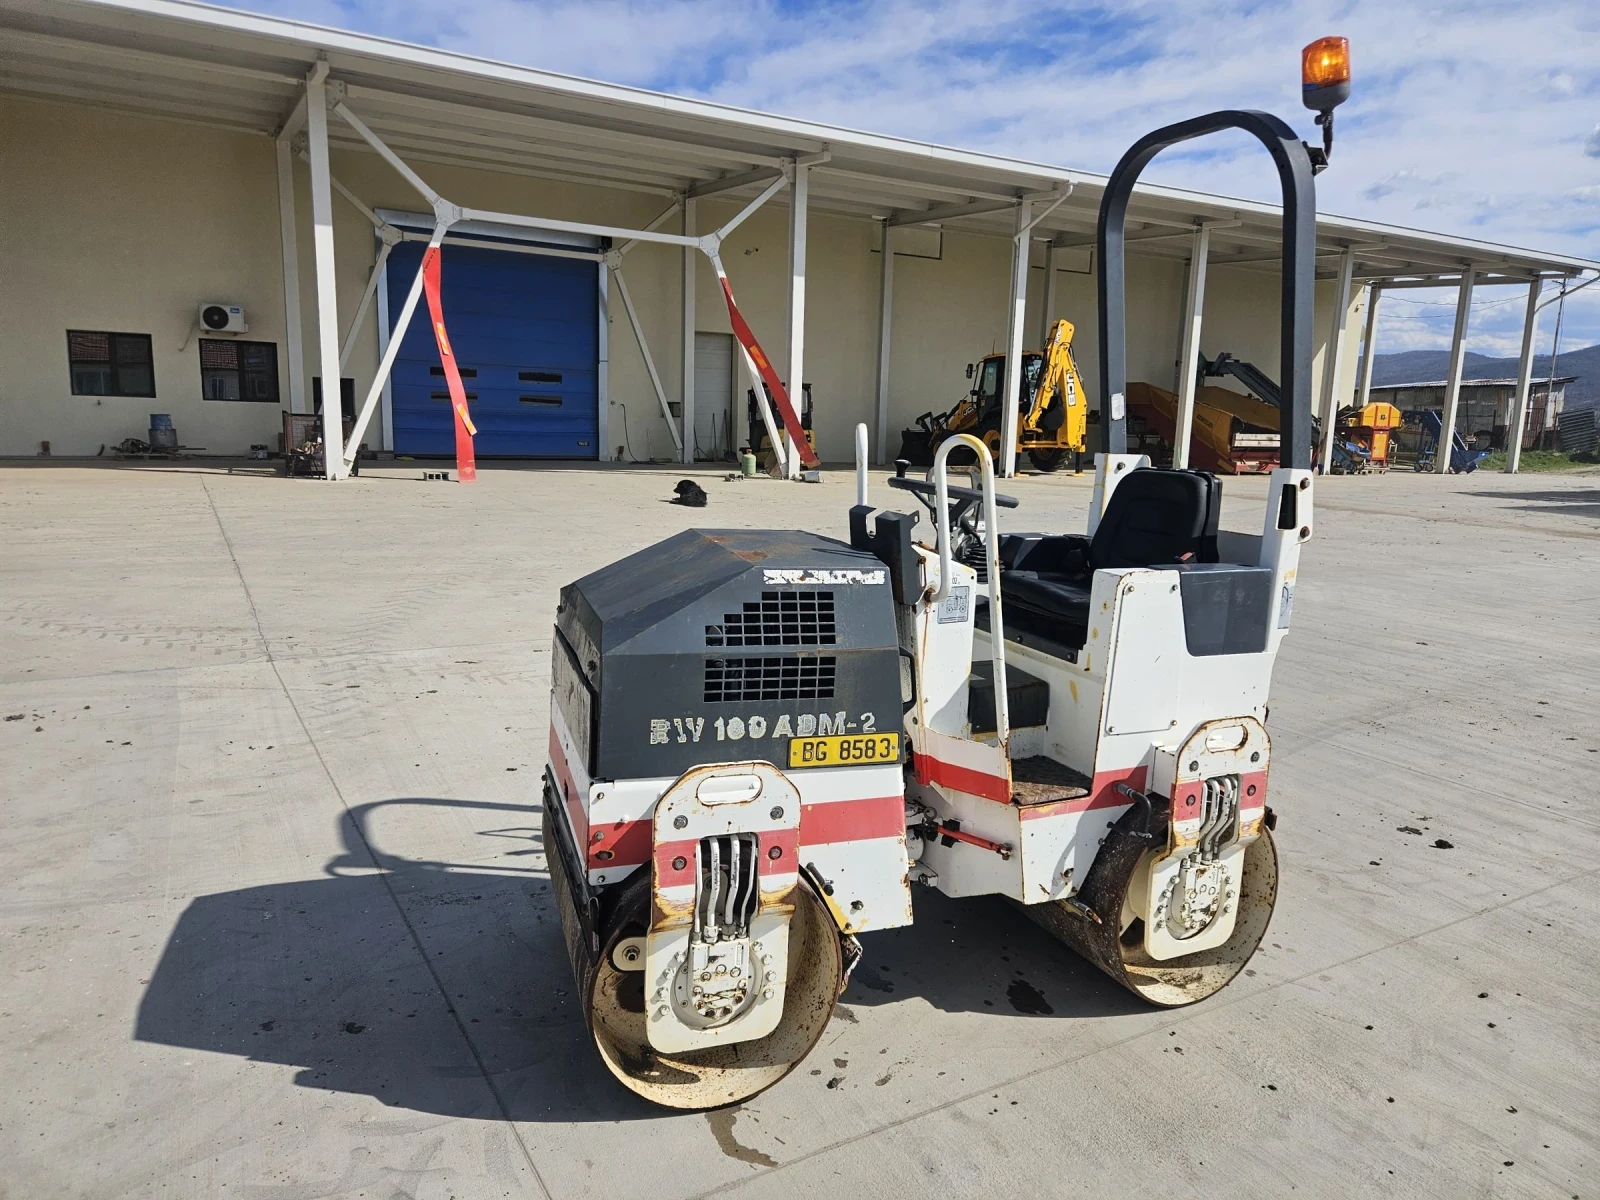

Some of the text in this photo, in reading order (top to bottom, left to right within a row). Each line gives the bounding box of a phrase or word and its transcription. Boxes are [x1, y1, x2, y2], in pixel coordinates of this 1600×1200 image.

[714, 716, 767, 741] 100
[802, 738, 891, 762] BG 8583
